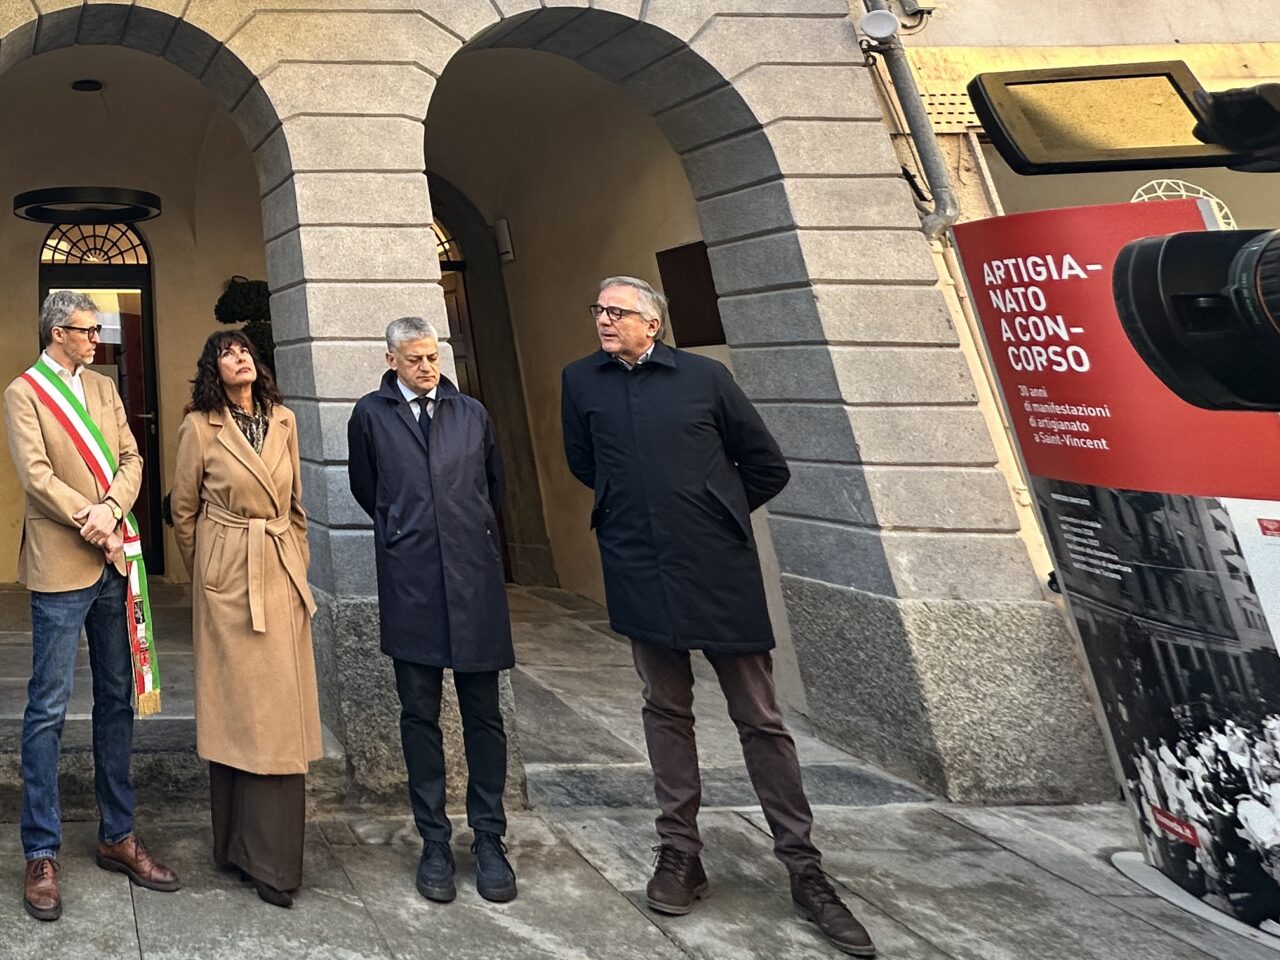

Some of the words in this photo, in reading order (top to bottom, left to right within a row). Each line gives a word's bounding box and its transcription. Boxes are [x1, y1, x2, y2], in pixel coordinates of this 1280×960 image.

[983, 253, 1103, 286] ARTIGIA-
[989, 286, 1047, 313] NATO
[1001, 318, 1016, 342] A
[1014, 315, 1085, 342] CON-
[1008, 345, 1090, 373] CORSO
[1029, 386, 1048, 397] anni
[1024, 401, 1032, 411] di
[1032, 402, 1111, 417] manifestazioni
[1029, 416, 1037, 427] di
[1037, 417, 1089, 432] artigianato
[1033, 433, 1040, 442] a
[1039, 432, 1110, 450] Saint-Vincent
